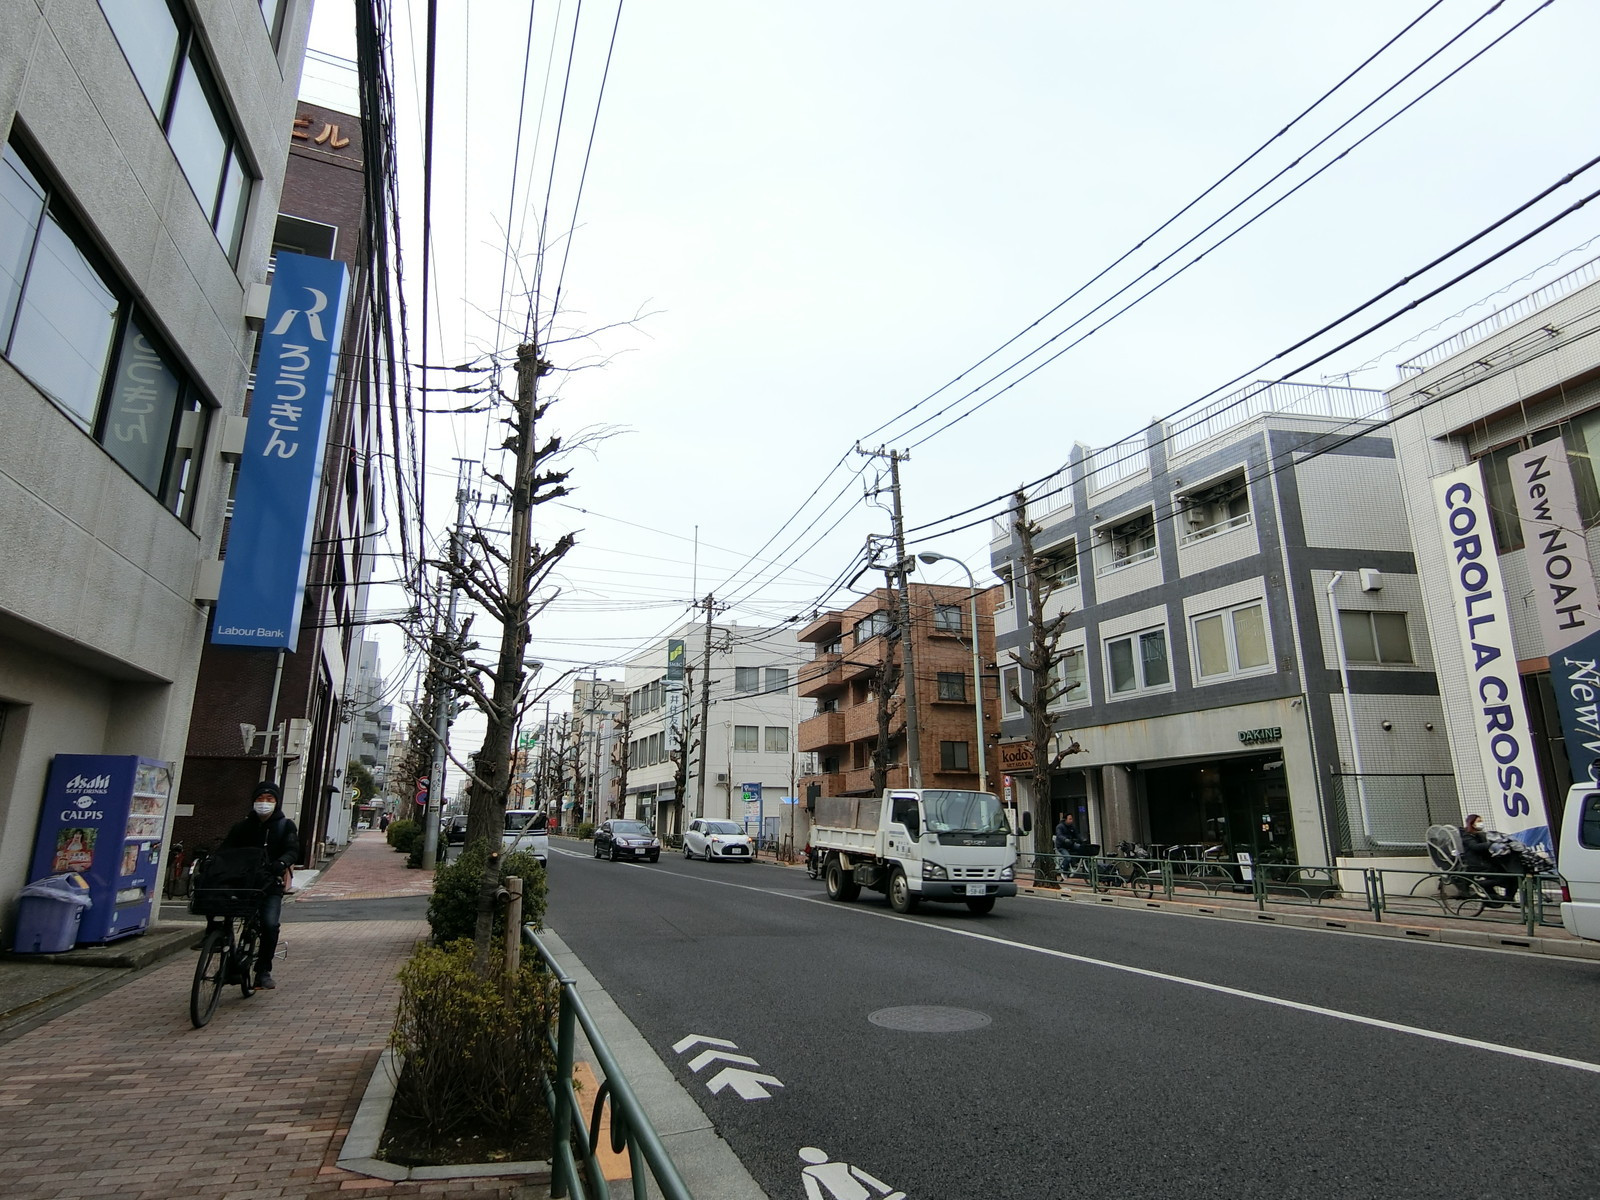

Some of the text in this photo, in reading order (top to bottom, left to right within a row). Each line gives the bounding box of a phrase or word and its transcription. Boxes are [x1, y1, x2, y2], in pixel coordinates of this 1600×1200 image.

[262, 343, 311, 459] ろうきん
[1524, 455, 1585, 631] New NOAH
[218, 625, 284, 638] Labour Bank
[1445, 482, 1530, 818] COROLLA CROSS
[1563, 656, 1600, 731] New
[1238, 726, 1282, 741] DAKINE
[66, 774, 111, 788] Asahi
[60, 810, 104, 821] CALPIS
